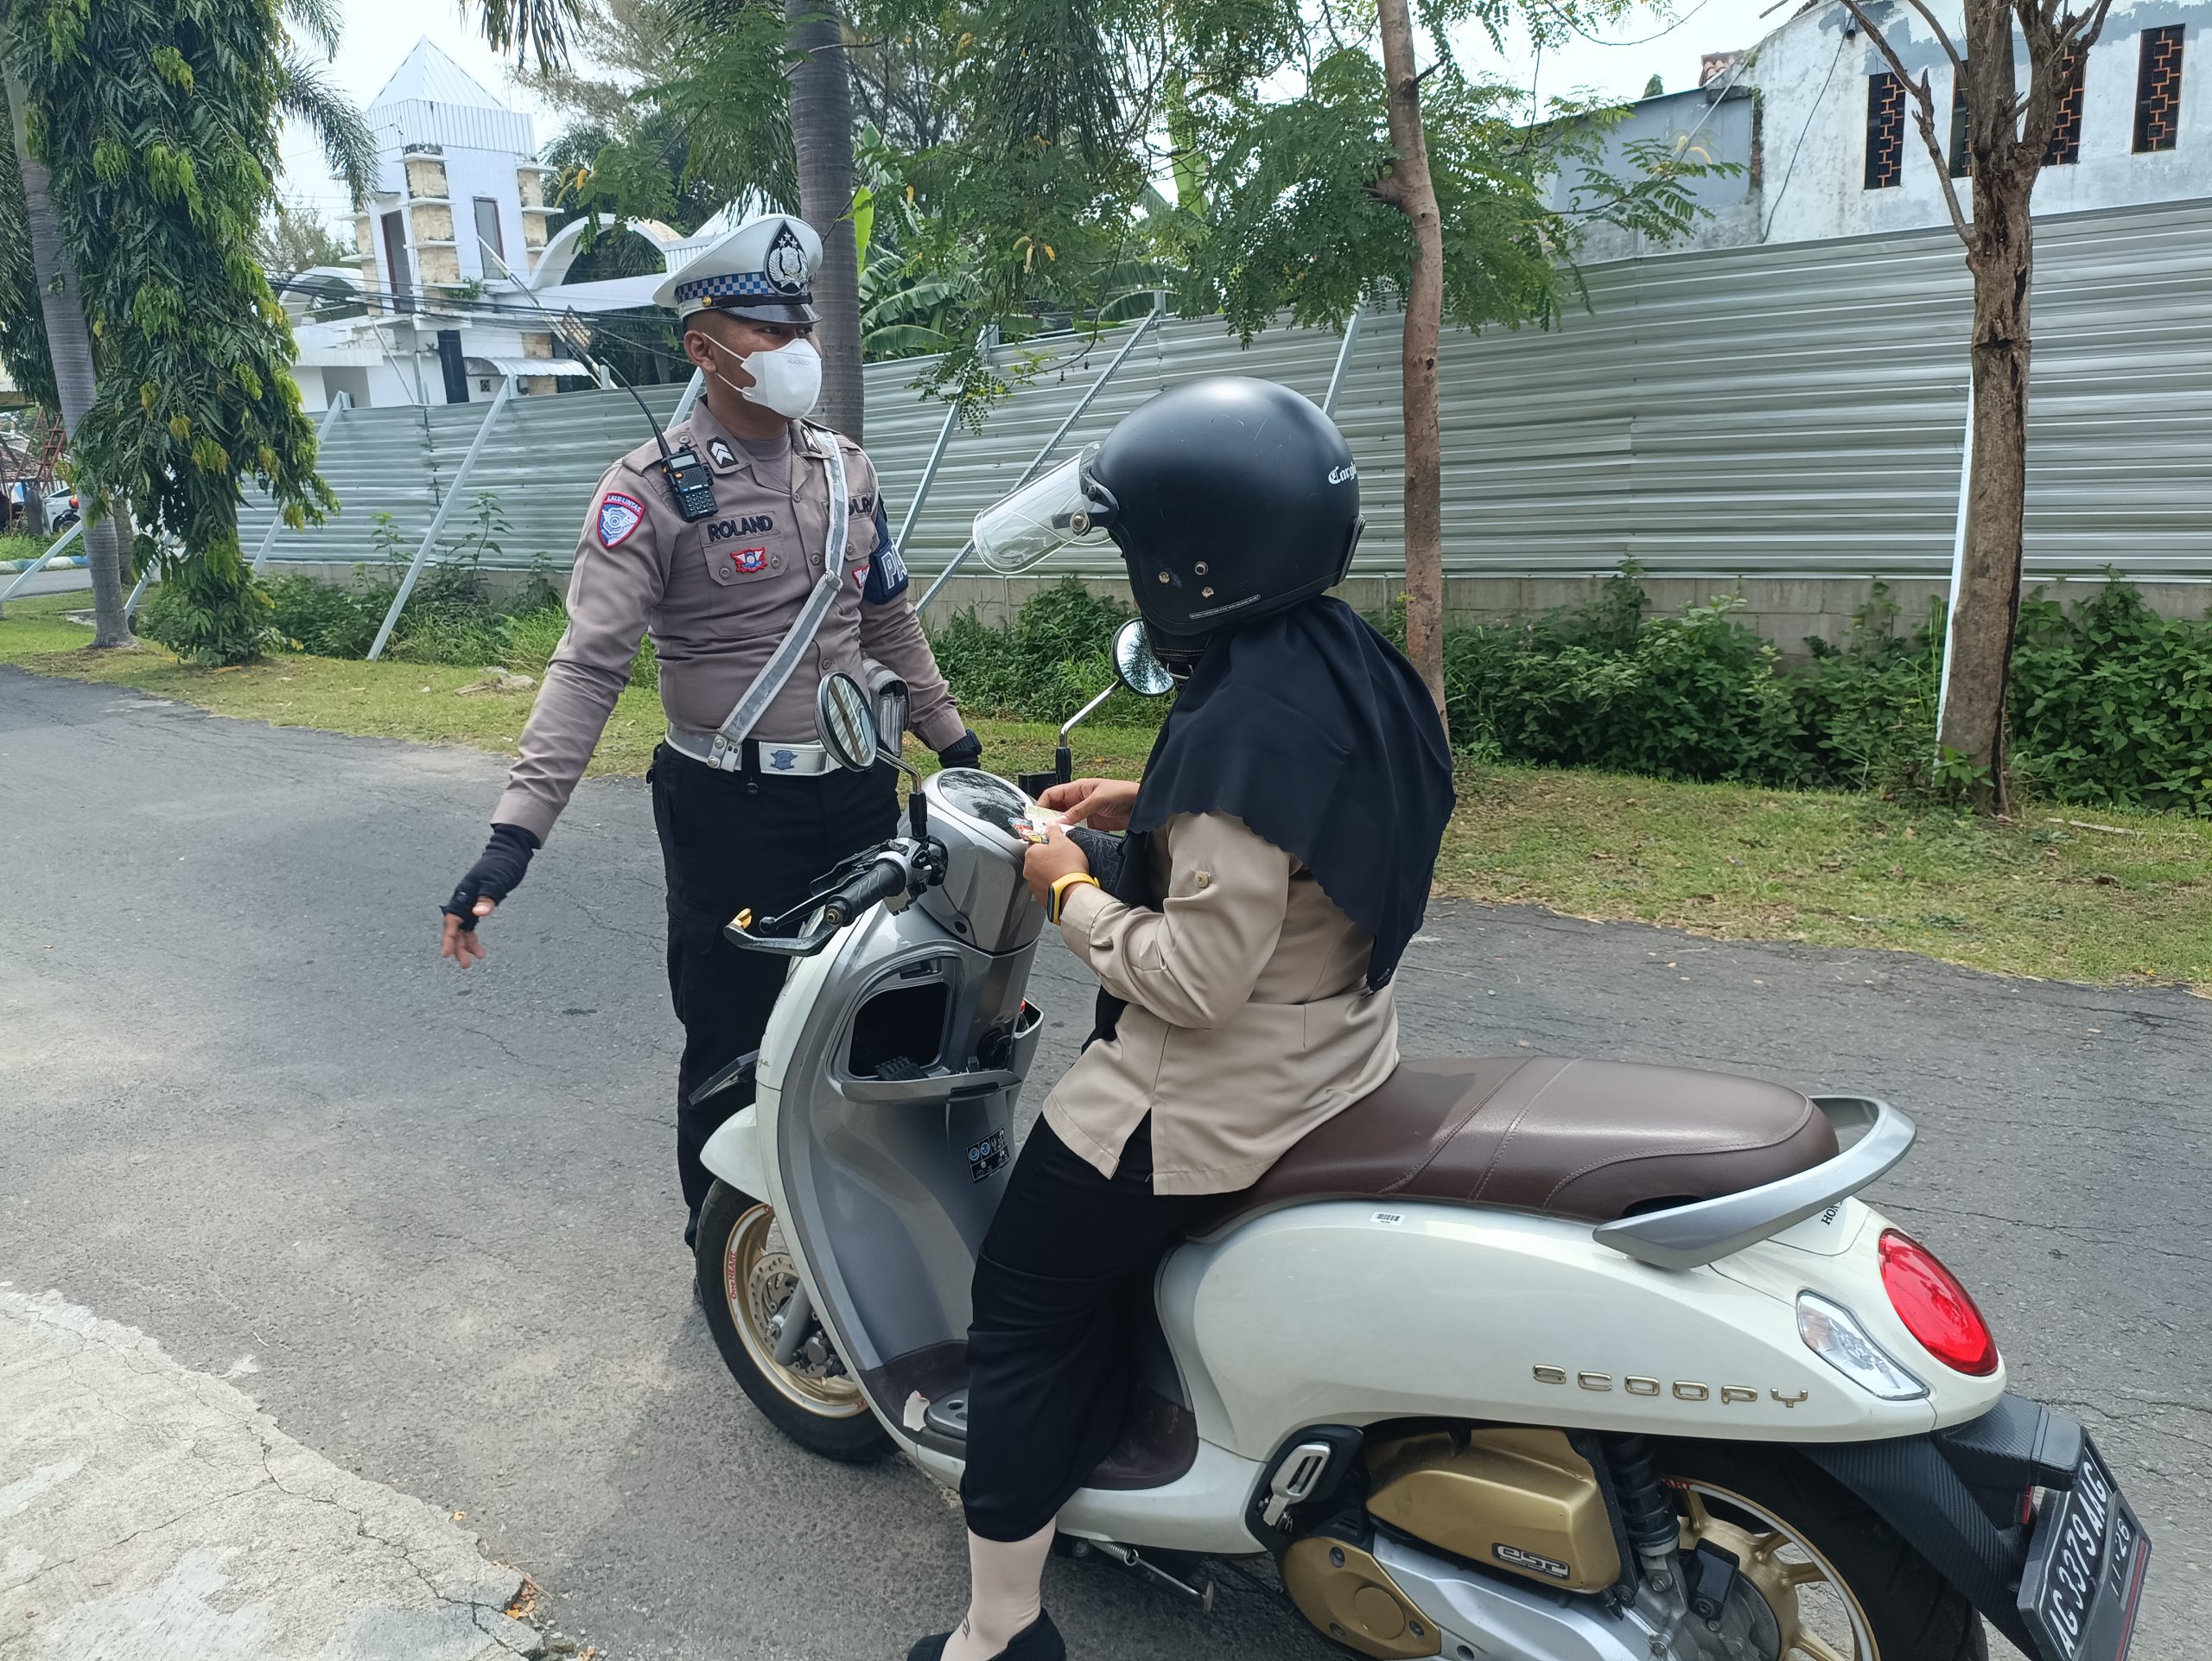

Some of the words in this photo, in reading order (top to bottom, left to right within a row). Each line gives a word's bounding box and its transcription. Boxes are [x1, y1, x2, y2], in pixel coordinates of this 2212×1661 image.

[707, 515, 773, 542] ROLAND
[1532, 1365, 1808, 1409] SCOOPY
[2078, 1461, 2107, 1537] AAG
[2058, 1513, 2097, 1610] 3379
[2050, 1589, 2079, 1659] AG
